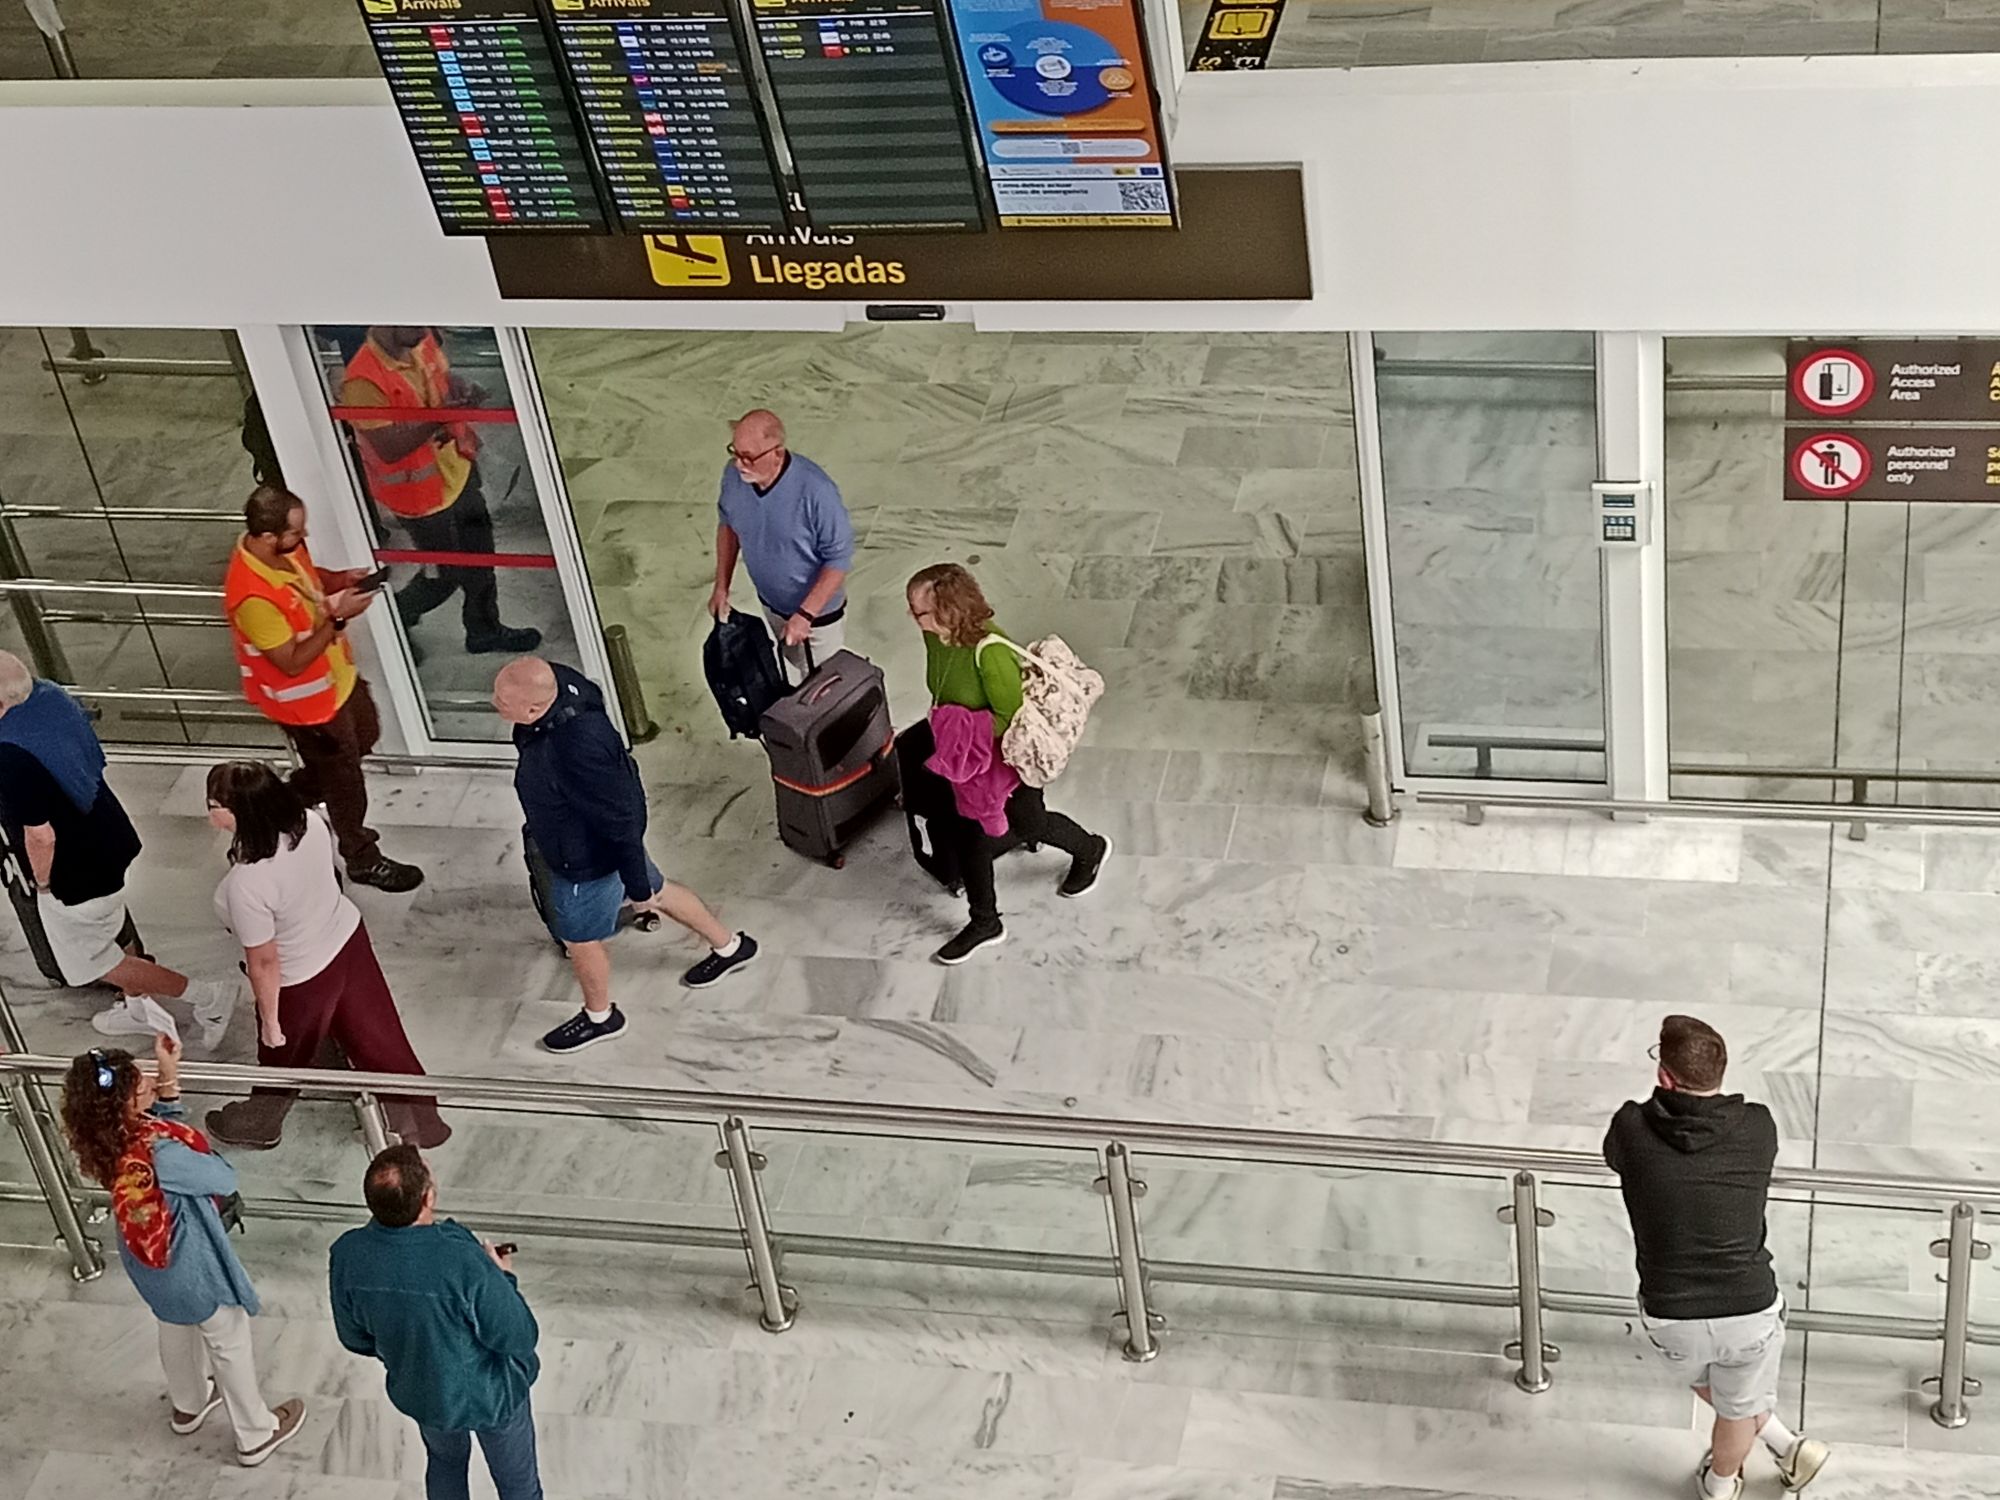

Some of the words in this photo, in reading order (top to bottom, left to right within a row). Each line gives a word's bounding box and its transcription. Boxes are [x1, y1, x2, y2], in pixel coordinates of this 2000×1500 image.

[750, 254, 907, 290] Llegadas
[1890, 363, 1961, 376] Authorized
[1890, 376, 1936, 388] Access
[1889, 389, 1921, 401] Area
[1887, 445, 1956, 457] Authorized
[1887, 459, 1949, 472] personnel
[1886, 472, 1914, 485] only
